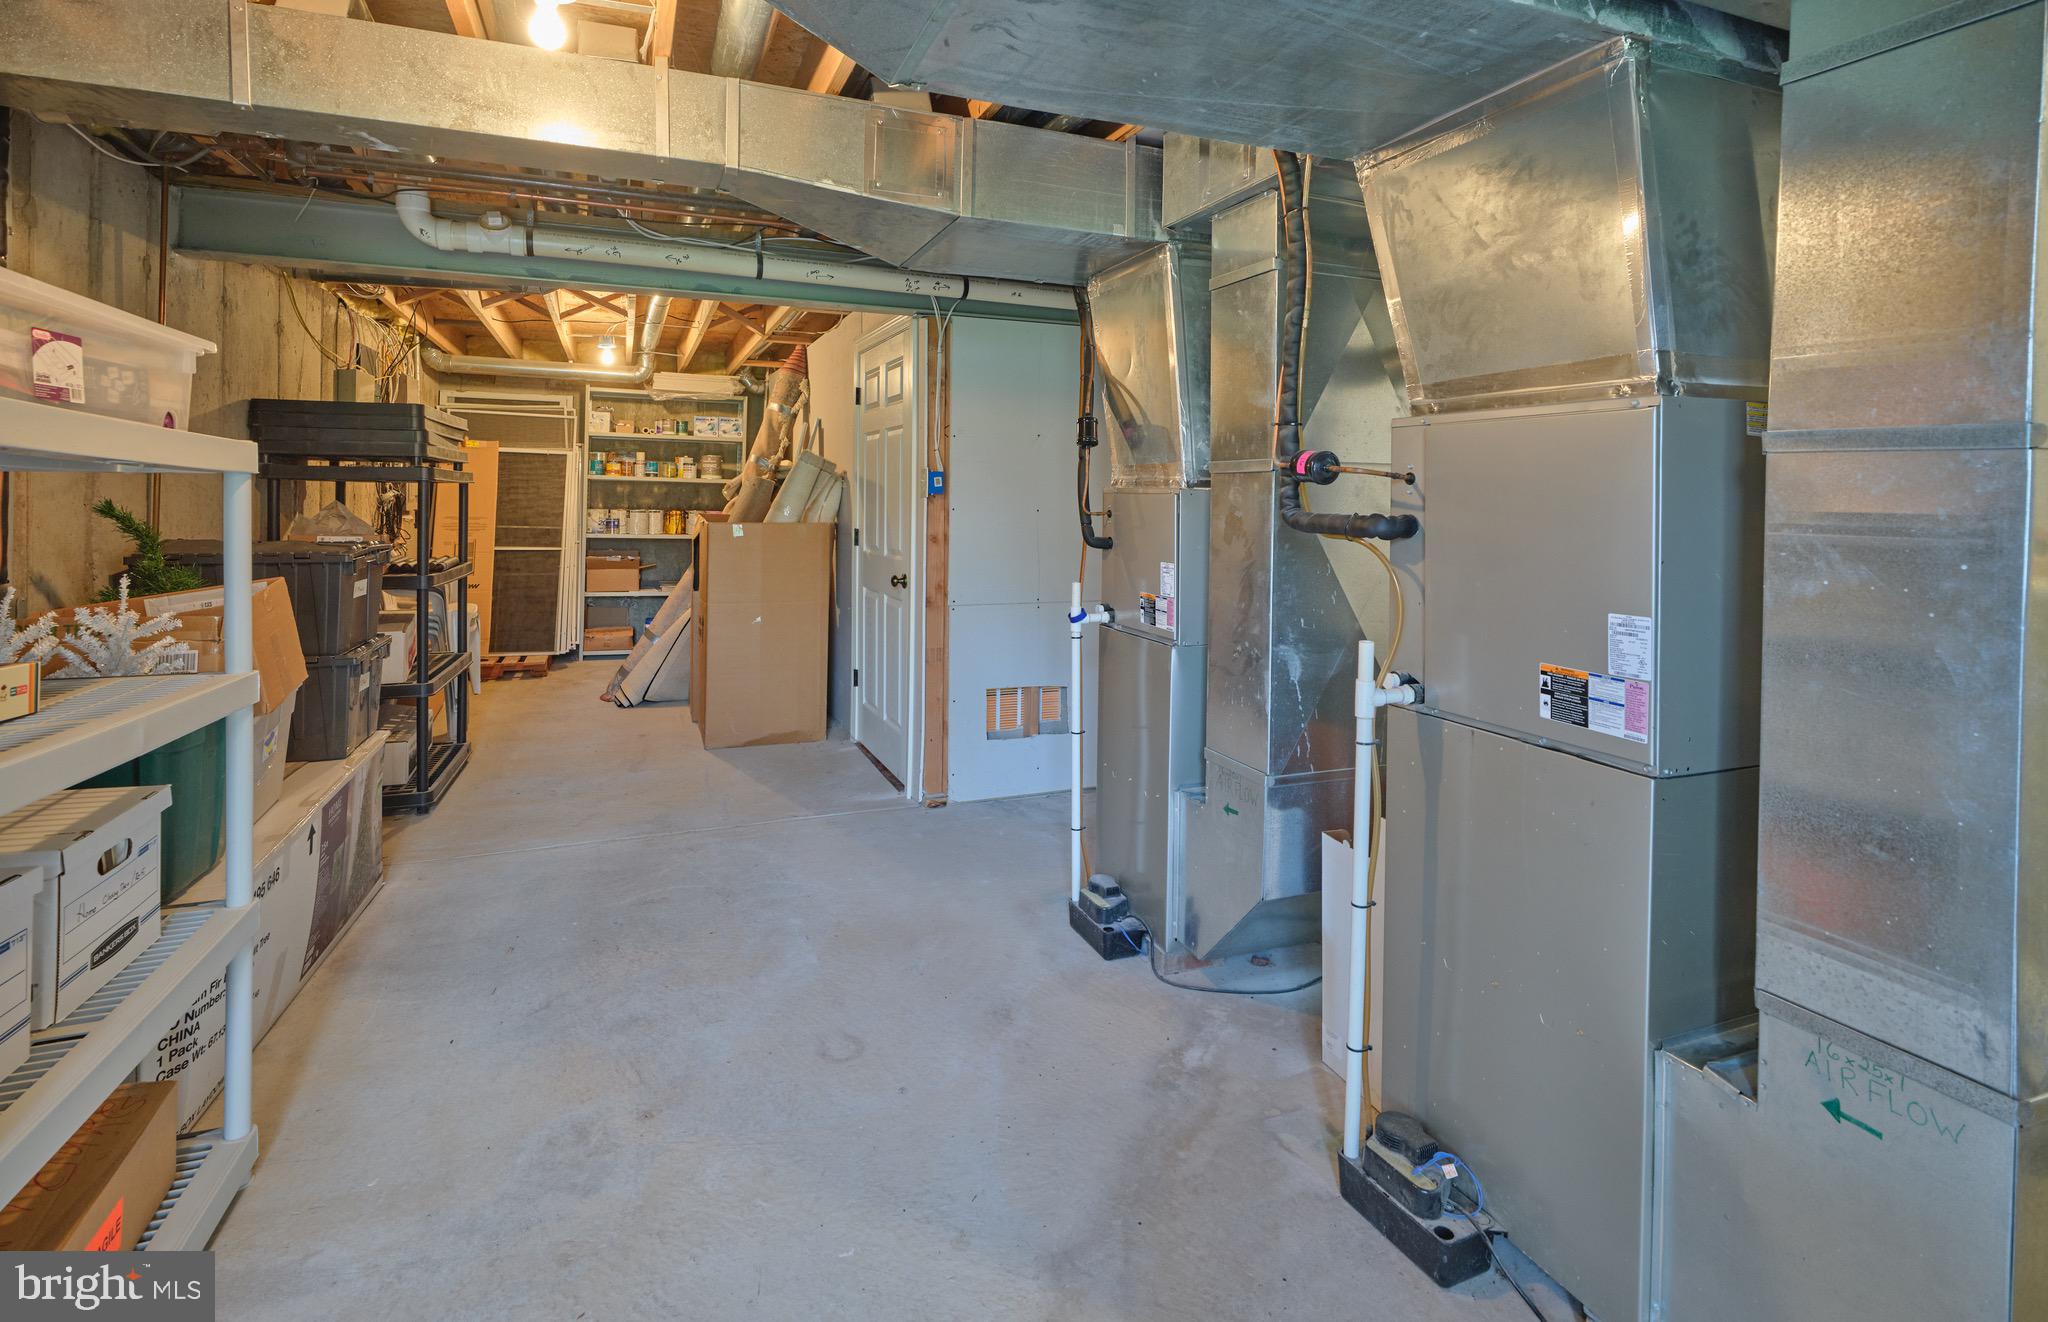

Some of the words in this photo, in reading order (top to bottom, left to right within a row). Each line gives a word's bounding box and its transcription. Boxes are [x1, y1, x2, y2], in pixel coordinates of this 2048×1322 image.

[93, 933, 124, 962] BANKERS
[123, 923, 137, 939] BOX
[209, 978, 223, 994] Fir
[157, 1021, 201, 1052] CHINA
[156, 1055, 163, 1068] 1
[168, 1037, 199, 1062] Pack
[155, 1060, 189, 1082] Case
[1804, 1050, 1966, 1144] AIRFLOW
